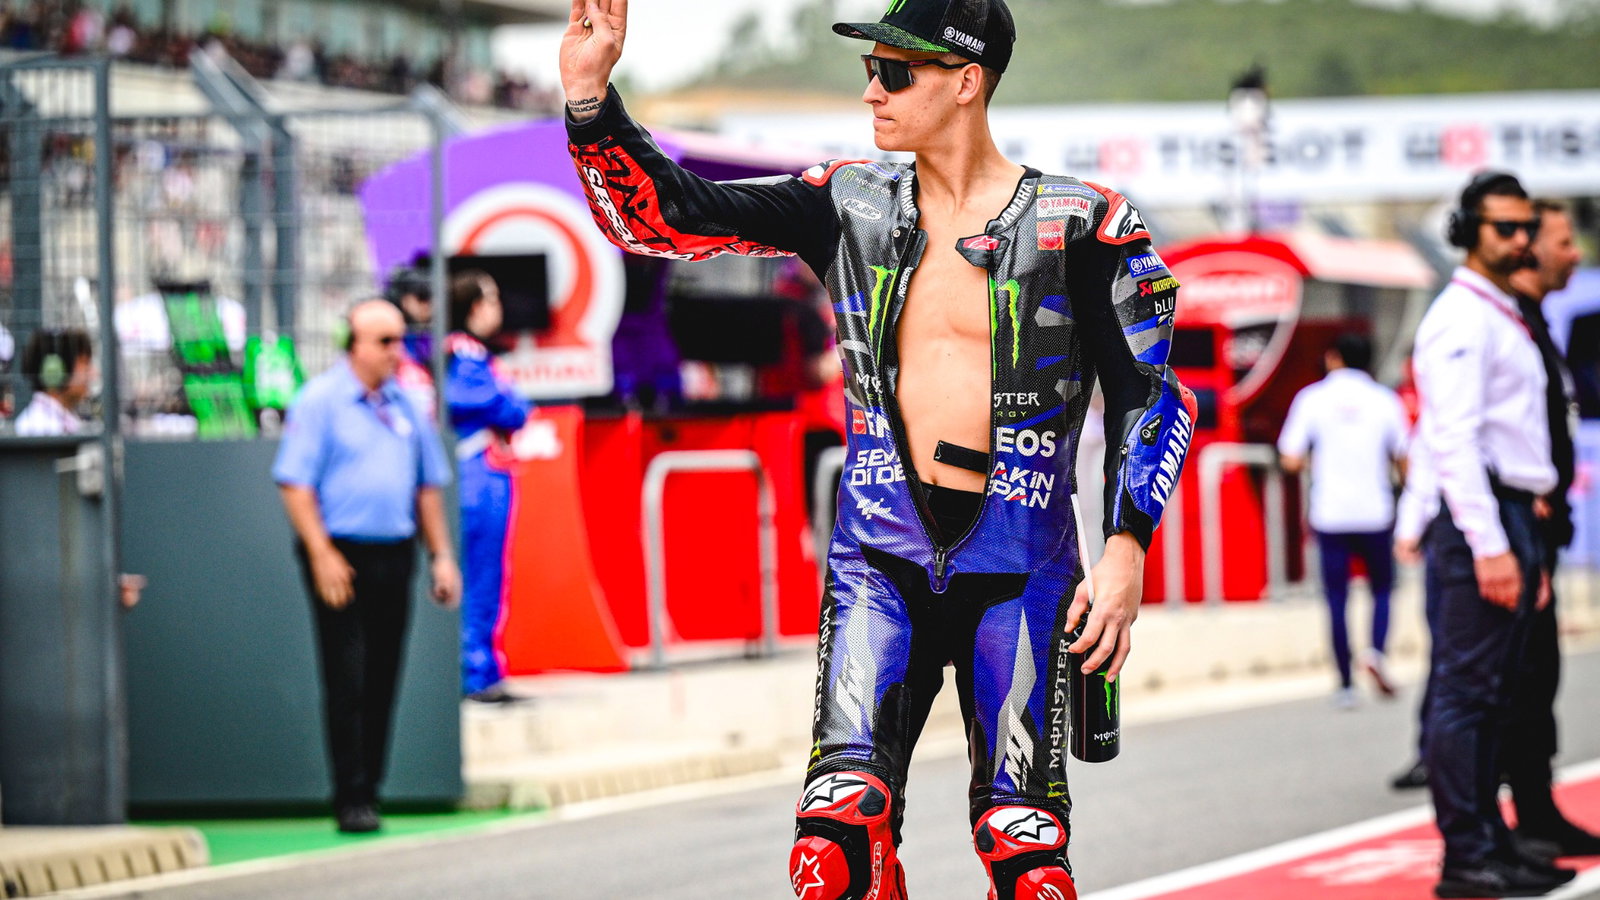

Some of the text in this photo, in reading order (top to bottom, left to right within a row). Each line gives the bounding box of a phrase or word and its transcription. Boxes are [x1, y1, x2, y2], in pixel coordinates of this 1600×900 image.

[901, 173, 915, 218] YAMAHA
[999, 183, 1033, 229] YAMAHA
[1050, 198, 1089, 211] YAMAHA
[1150, 407, 1191, 508] YAMAHA
[987, 479, 1051, 510] PAN
[1048, 639, 1070, 769] MONSTER
